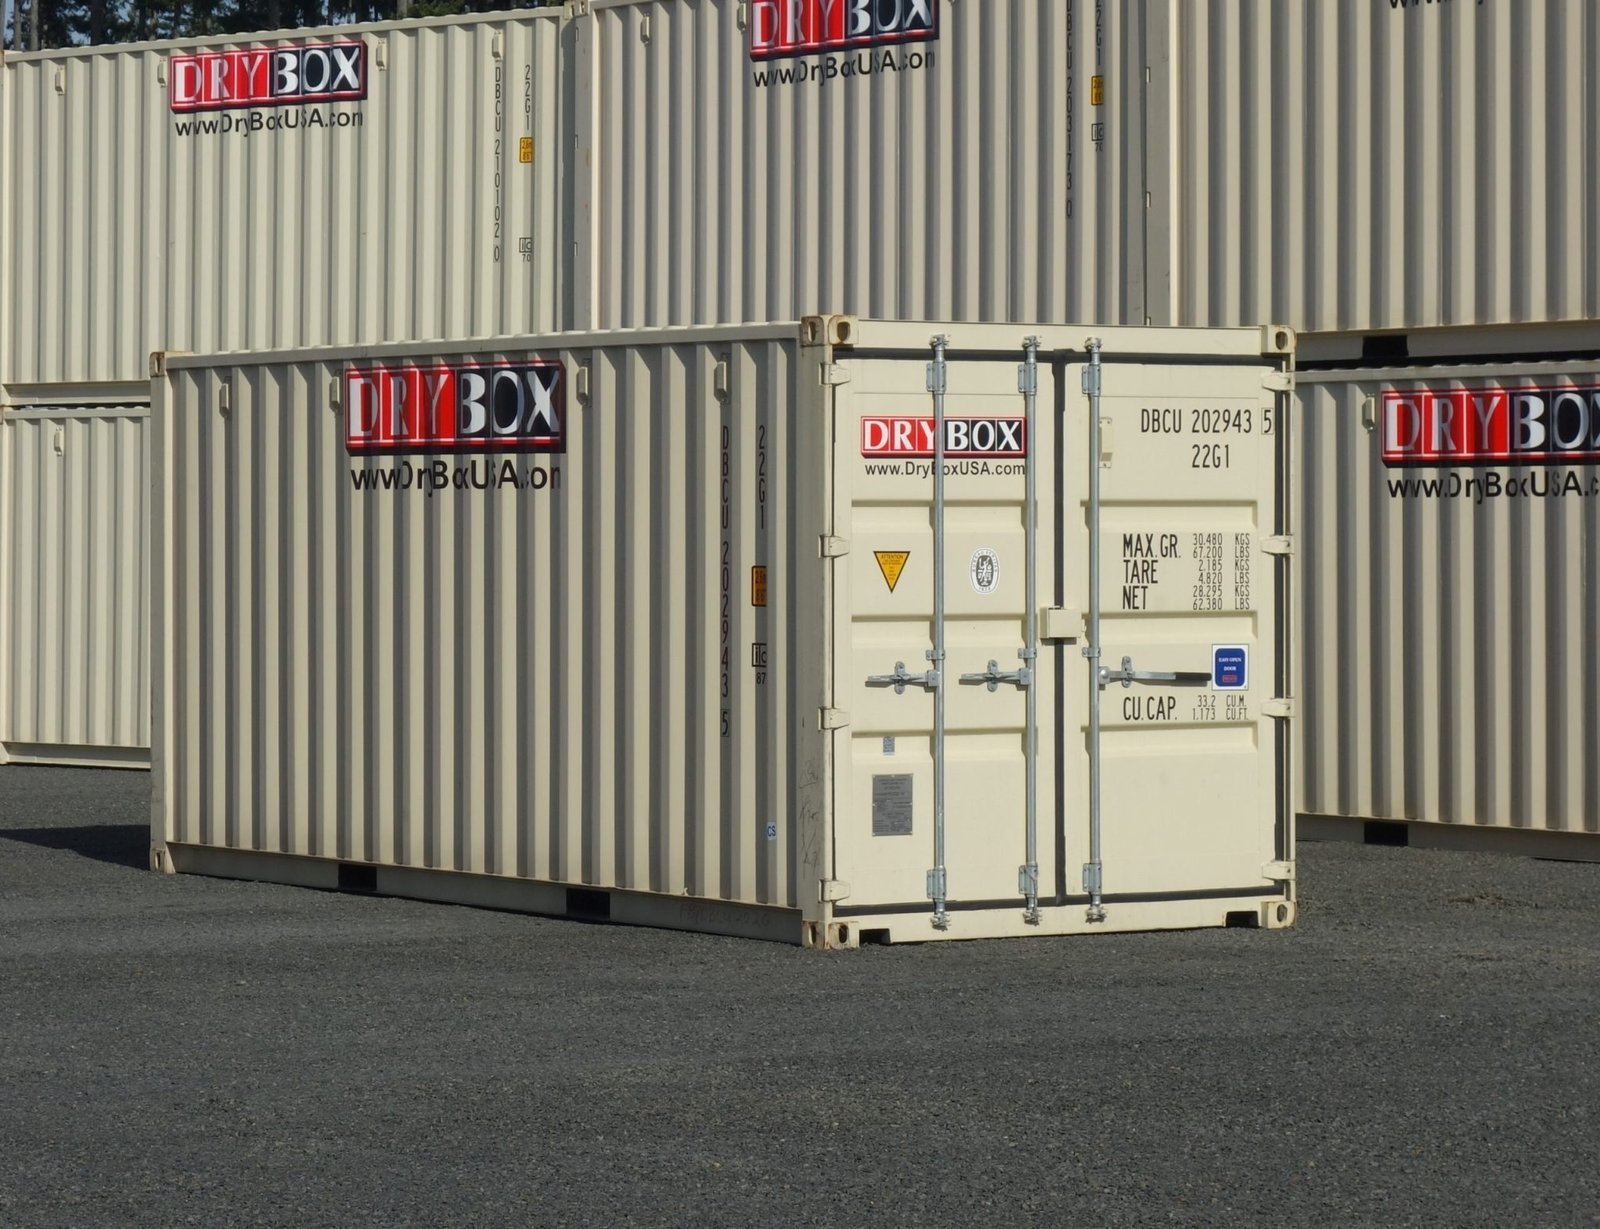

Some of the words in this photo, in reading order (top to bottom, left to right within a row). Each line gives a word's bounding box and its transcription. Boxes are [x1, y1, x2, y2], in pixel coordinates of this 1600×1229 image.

[174, 46, 361, 100] DRYBOX
[349, 369, 560, 437] DRYBOX
[1141, 408, 1182, 433] DBCU
[1191, 408, 1252, 433] 202943
[1263, 409, 1272, 433] 5
[862, 420, 1021, 451] DRYBOX
[1191, 444, 1229, 468] 22G1
[758, 425, 766, 529] 22G1
[1192, 533, 1223, 546] 30.480
[1234, 533, 1250, 546] KGS
[1192, 546, 1223, 559] 67.200
[1234, 546, 1250, 559] LBS
[1123, 560, 1158, 584] TARE
[1198, 559, 1223, 571] 2.185
[1234, 559, 1250, 571] KGS
[1198, 572, 1223, 584] 4.820
[1234, 572, 1250, 584] LBS
[1122, 586, 1148, 610] NET
[1192, 585, 1223, 597] 28.295
[1234, 585, 1250, 597] KGS
[1192, 598, 1223, 610] 62.380
[1234, 598, 1250, 610] LBS
[721, 540, 729, 698] 202943
[756, 672, 766, 685] 87
[1197, 695, 1216, 707] 33.2
[722, 710, 729, 736] 5
[1192, 708, 1216, 720] 1.173
